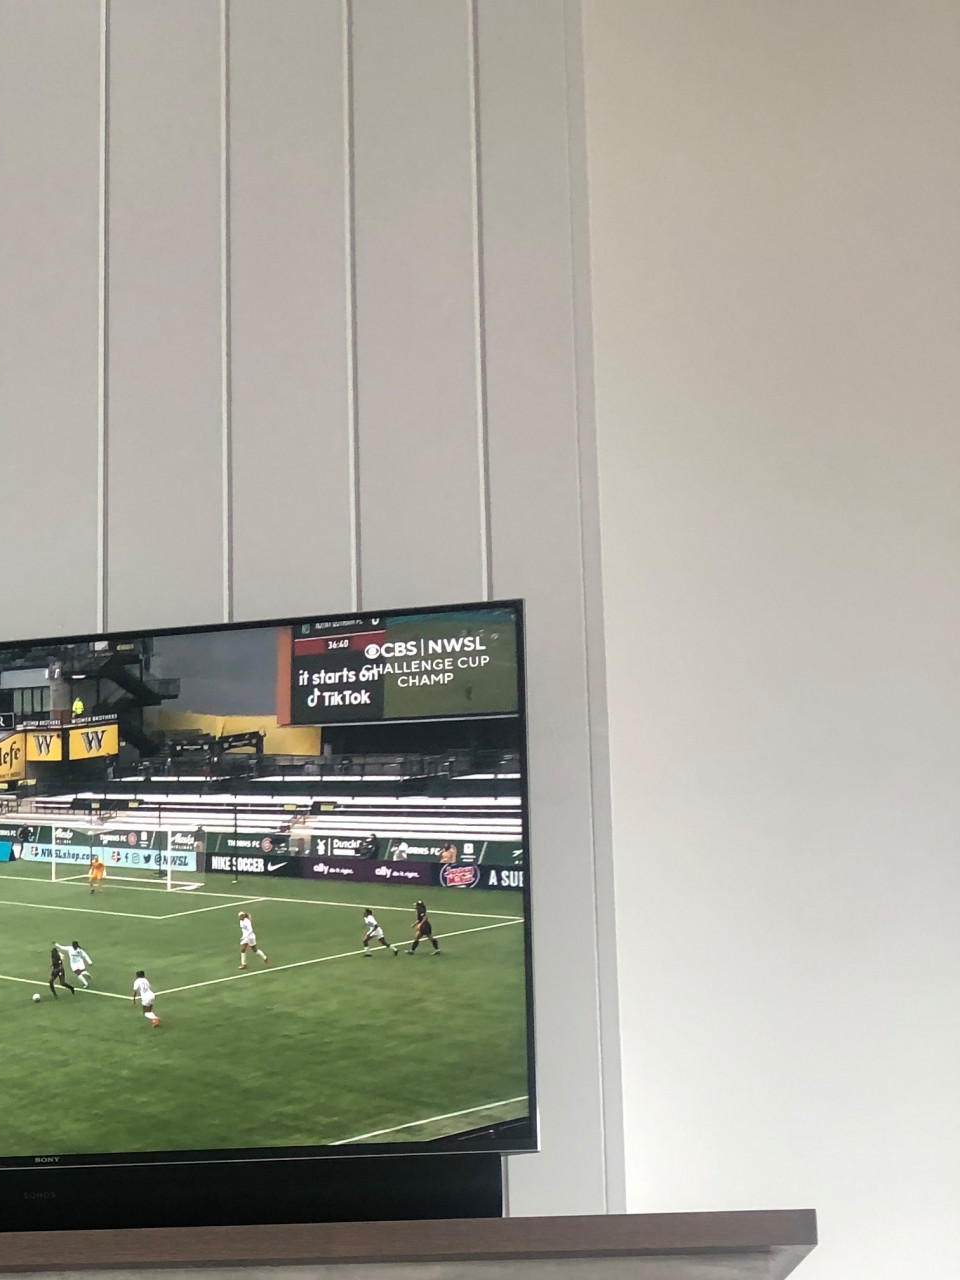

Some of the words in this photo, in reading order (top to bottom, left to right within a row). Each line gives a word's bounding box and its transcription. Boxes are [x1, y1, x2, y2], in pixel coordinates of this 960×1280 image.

[380, 641, 418, 658] CBS
[428, 636, 487, 654] NWSL
[362, 658, 454, 676] CHALLENGE
[458, 655, 490, 669] CUP
[299, 669, 309, 686] it
[312, 667, 356, 685] starts
[359, 669, 379, 682] on
[397, 672, 454, 688] CHAMP
[323, 689, 371, 706] TikTok
[33, 735, 54, 756] W
[81, 730, 107, 753] W
[227, 839, 251, 847] THRNS
[211, 855, 231, 870] NIKE
[313, 863, 329, 875] ally
[375, 866, 392, 878] ally
[488, 870, 497, 885] A
